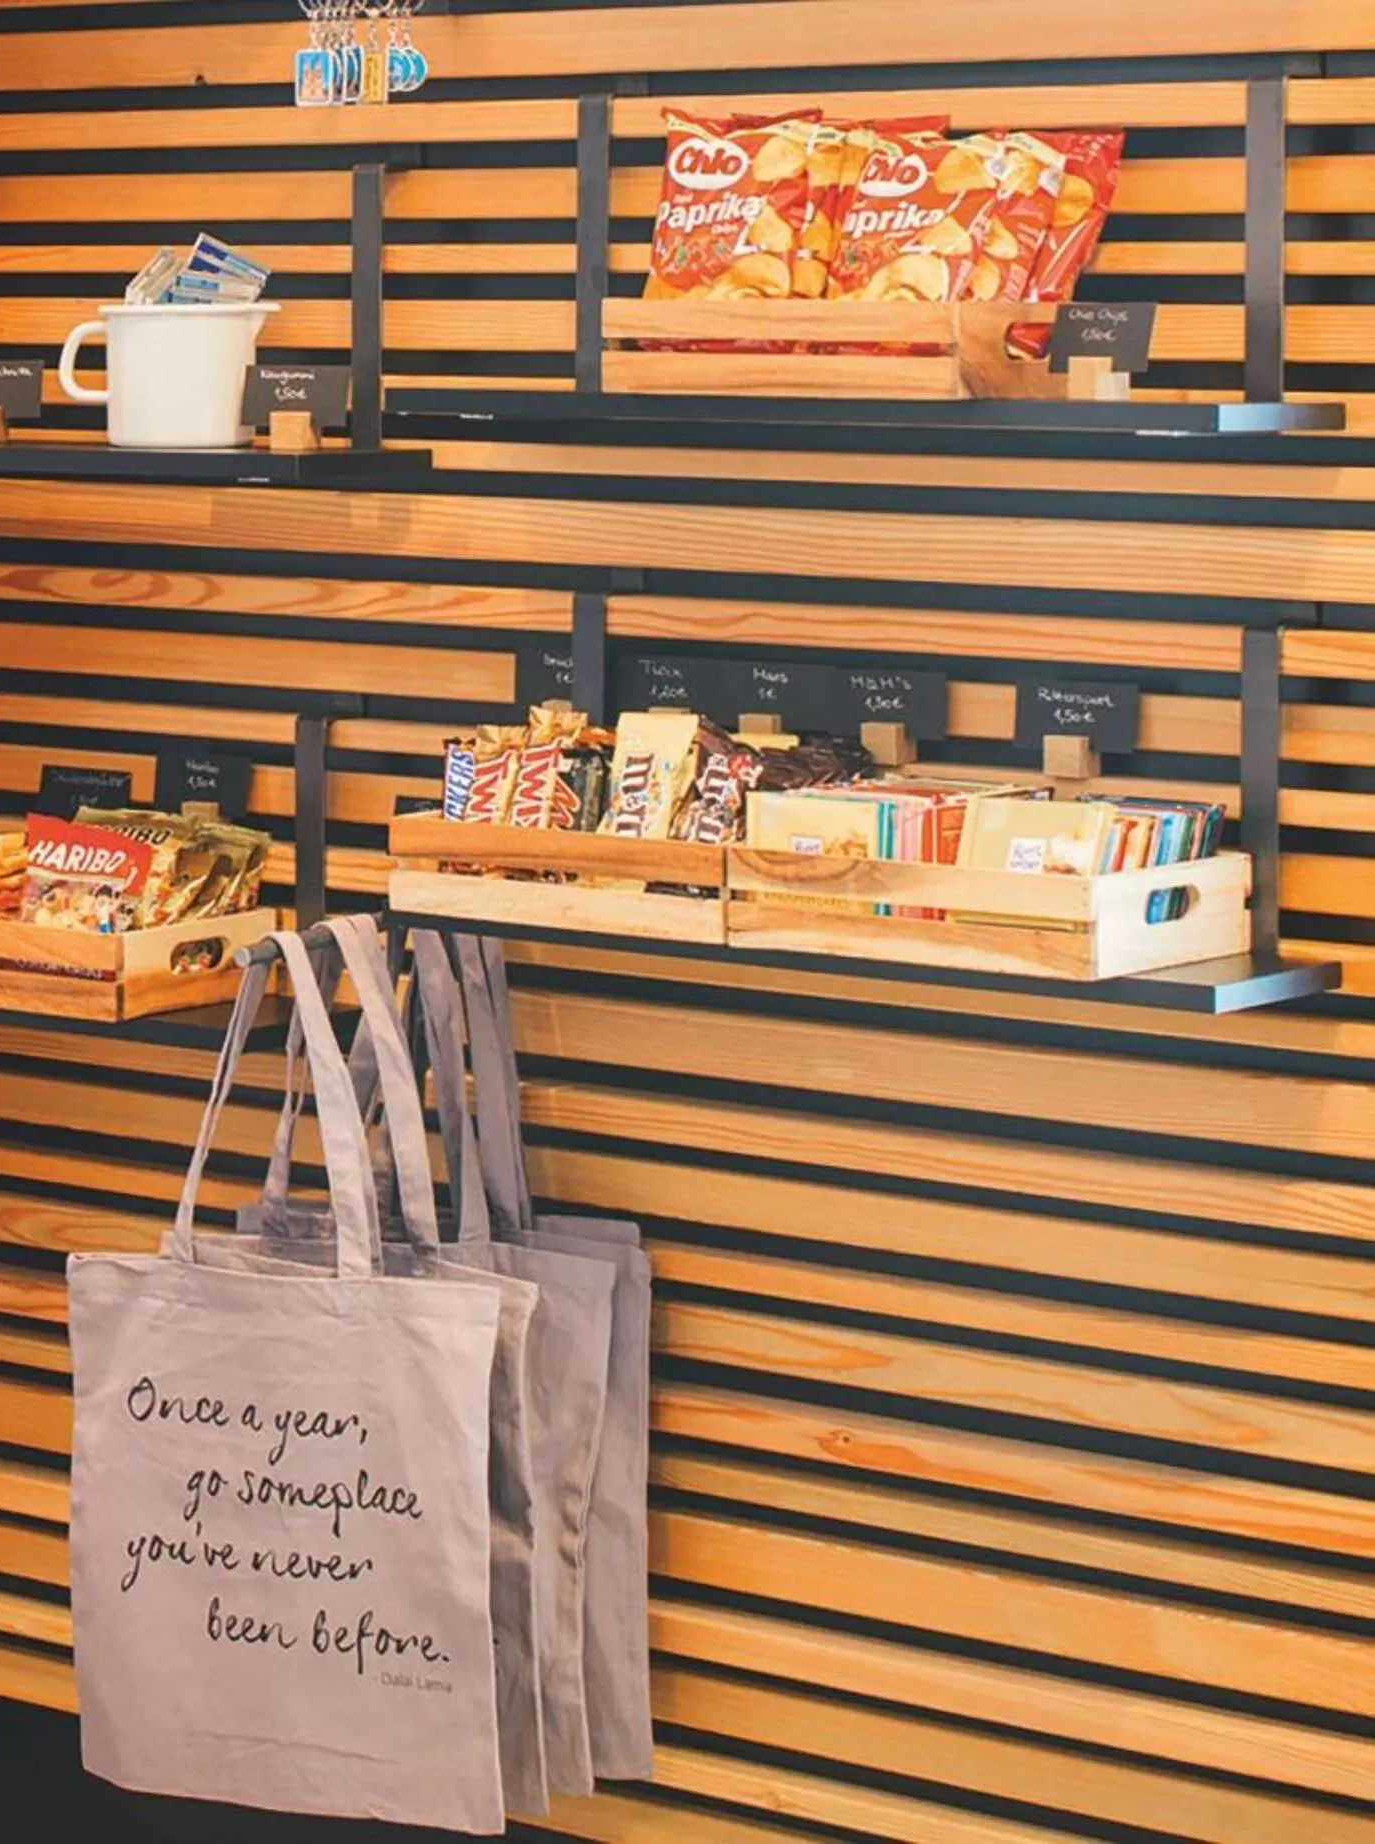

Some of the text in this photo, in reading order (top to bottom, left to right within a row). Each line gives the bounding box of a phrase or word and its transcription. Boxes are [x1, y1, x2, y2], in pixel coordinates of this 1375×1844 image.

[675, 145, 743, 175] Chio
[656, 191, 769, 234] Paprika
[843, 201, 947, 238] aprika
[27, 839, 127, 875] HARIBO
[126, 1376, 369, 1466] Once a year,
[183, 1468, 424, 1539] go someplace
[121, 1520, 374, 1592] you've never
[207, 1596, 451, 1675] been before.
